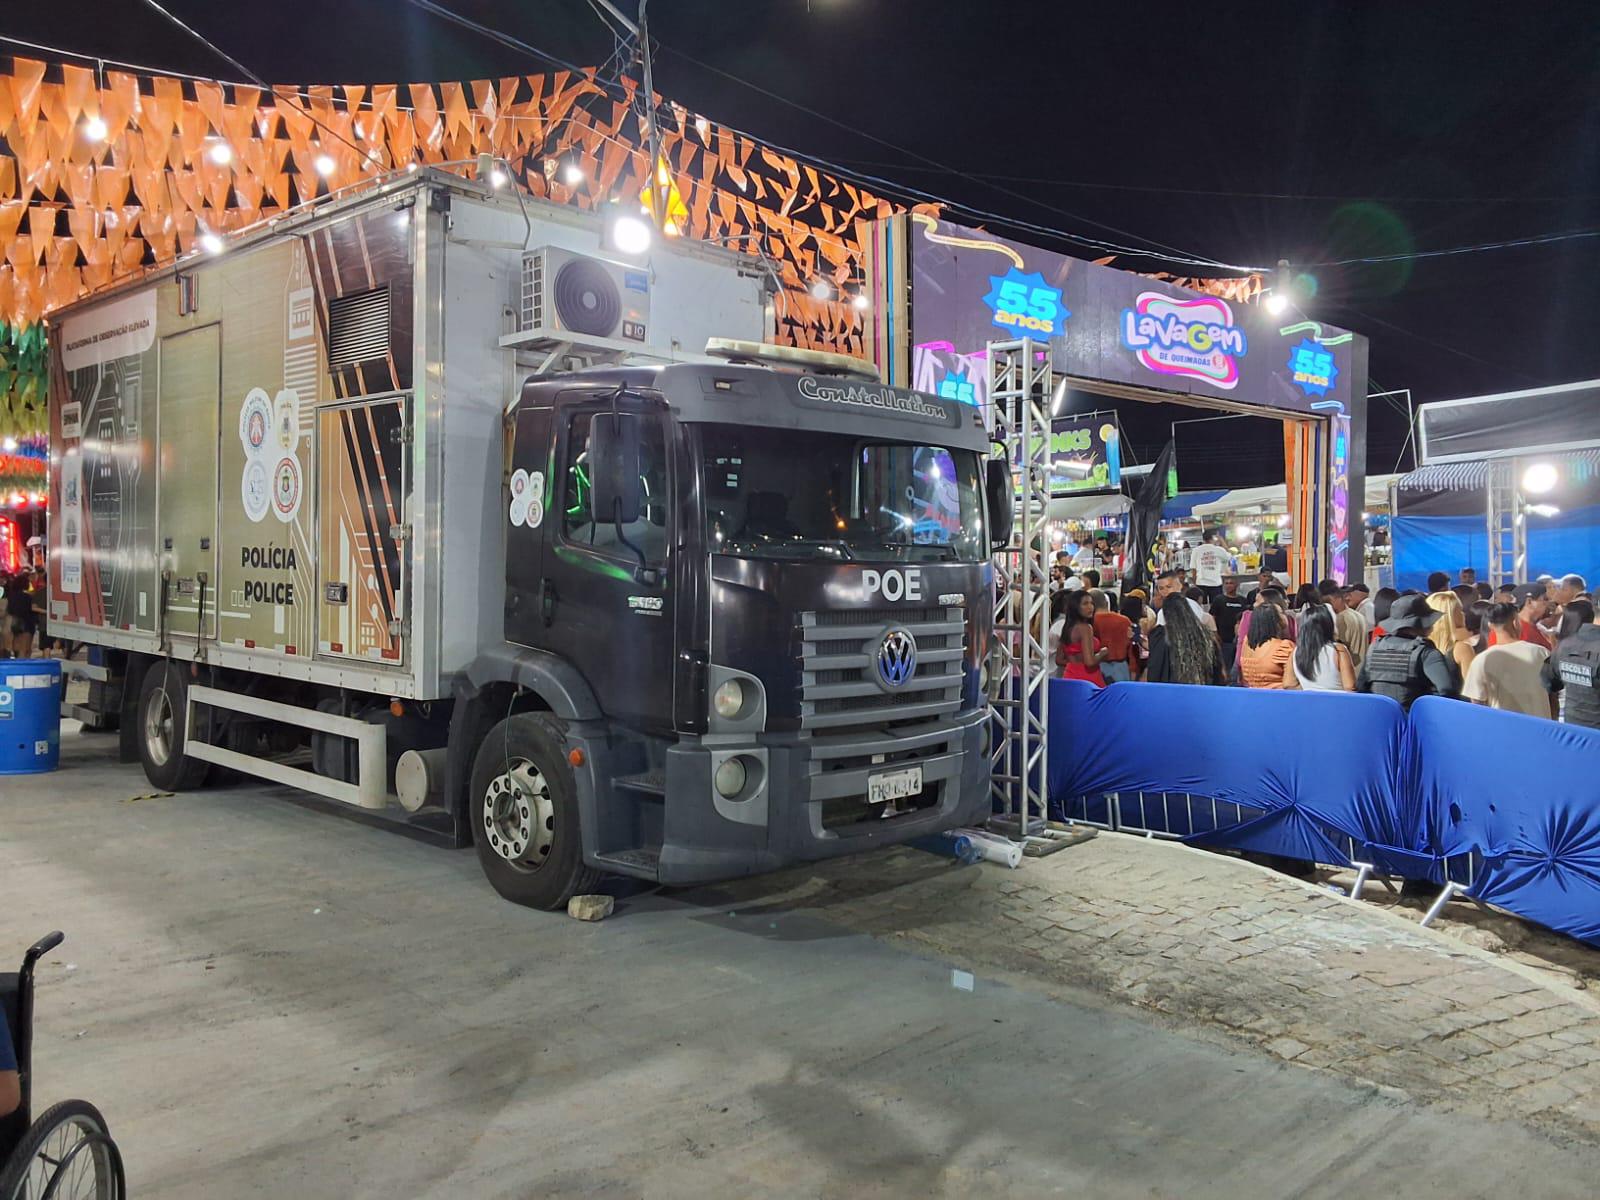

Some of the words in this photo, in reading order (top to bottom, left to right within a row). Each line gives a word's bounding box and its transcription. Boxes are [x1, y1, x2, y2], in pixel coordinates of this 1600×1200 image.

[996, 280, 1057, 321] 55
[995, 309, 1054, 333] anos
[1159, 351, 1169, 361] DE
[1171, 353, 1211, 367] QUEIMADAS
[1295, 348, 1331, 377] 55
[1293, 371, 1329, 387] anos
[797, 376, 948, 419] Constellation
[241, 541, 297, 570] POLÍCIA
[244, 580, 294, 605] POLICE
[862, 569, 922, 602] POE
[1560, 662, 1592, 677] ESCOLTA
